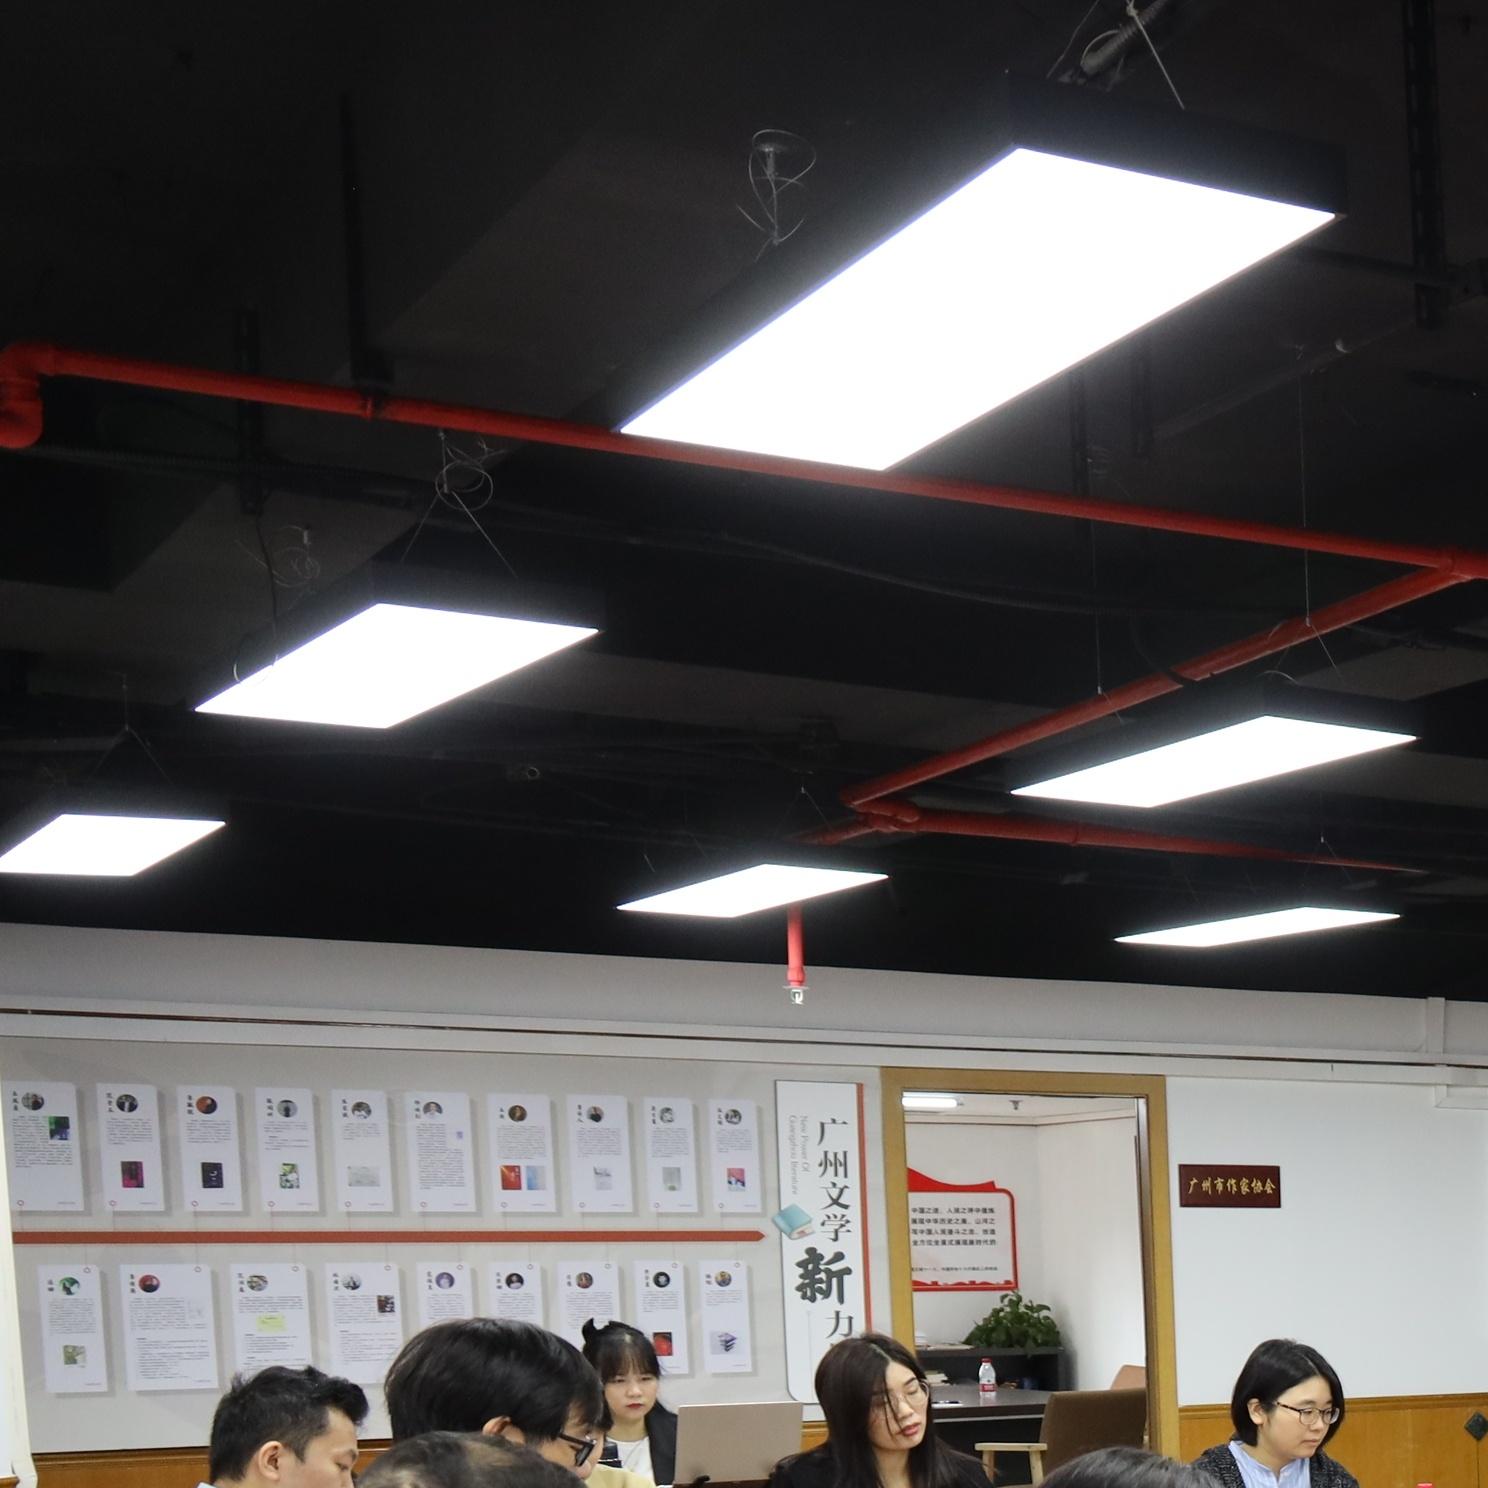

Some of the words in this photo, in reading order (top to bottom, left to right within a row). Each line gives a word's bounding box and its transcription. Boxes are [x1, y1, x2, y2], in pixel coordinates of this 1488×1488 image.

[795, 1117, 855, 1347] 广州文学新力
[1188, 1177, 1276, 1195] 广州市作家协会
